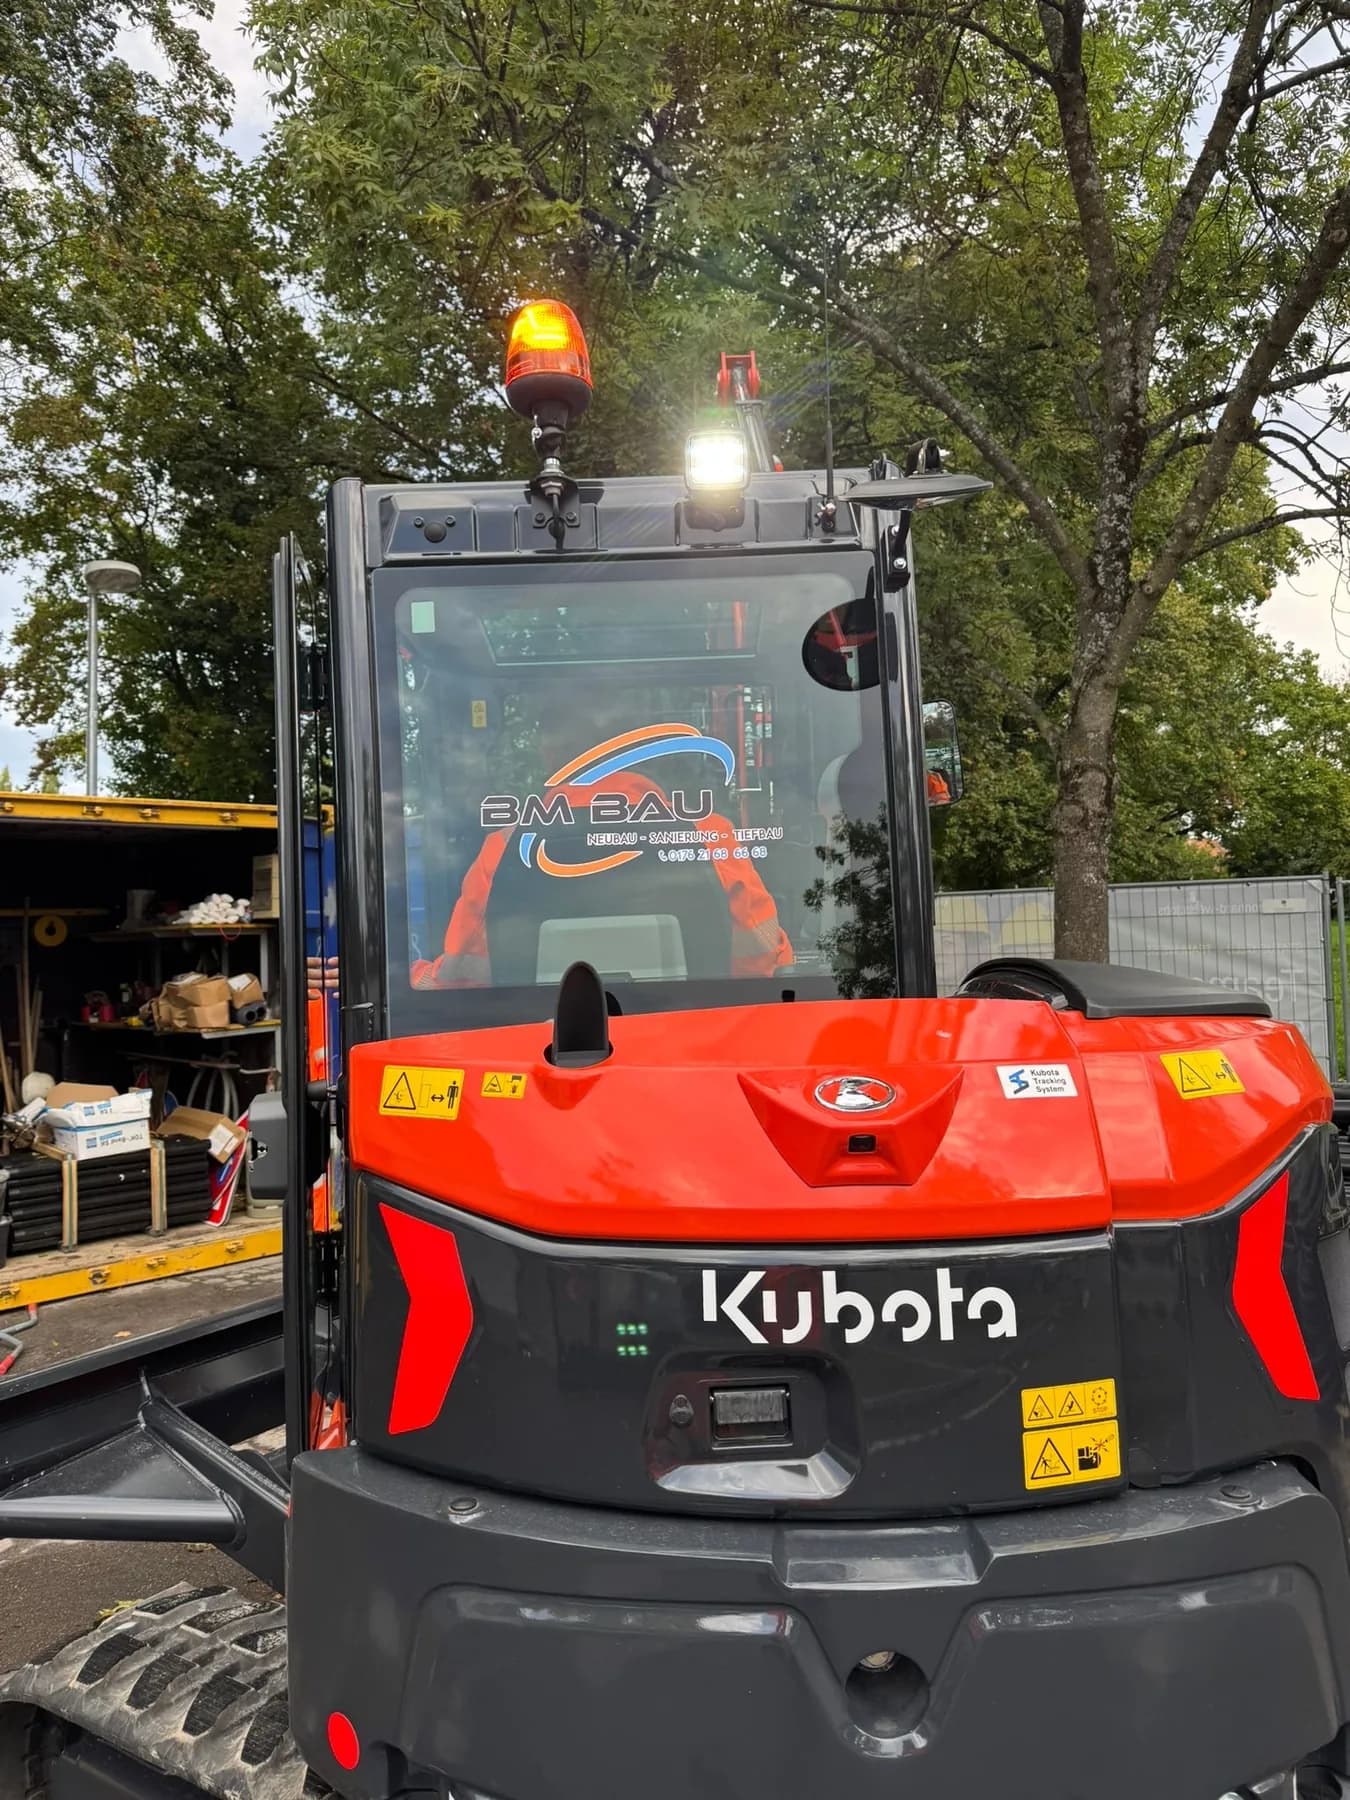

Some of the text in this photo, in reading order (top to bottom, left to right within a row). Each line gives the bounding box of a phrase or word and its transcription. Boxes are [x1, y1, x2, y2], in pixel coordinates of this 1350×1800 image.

[480, 789, 713, 826] BM BAU
[587, 833, 637, 846] NEUBAU
[649, 831, 719, 844] SANIERUNG
[732, 827, 784, 841] TIEFBAU
[667, 846, 768, 862] 0176 21 68 66 68
[1032, 1077, 1067, 1085] Tracking
[1035, 1086, 1065, 1094] System
[701, 1267, 1018, 1344] Kubota
